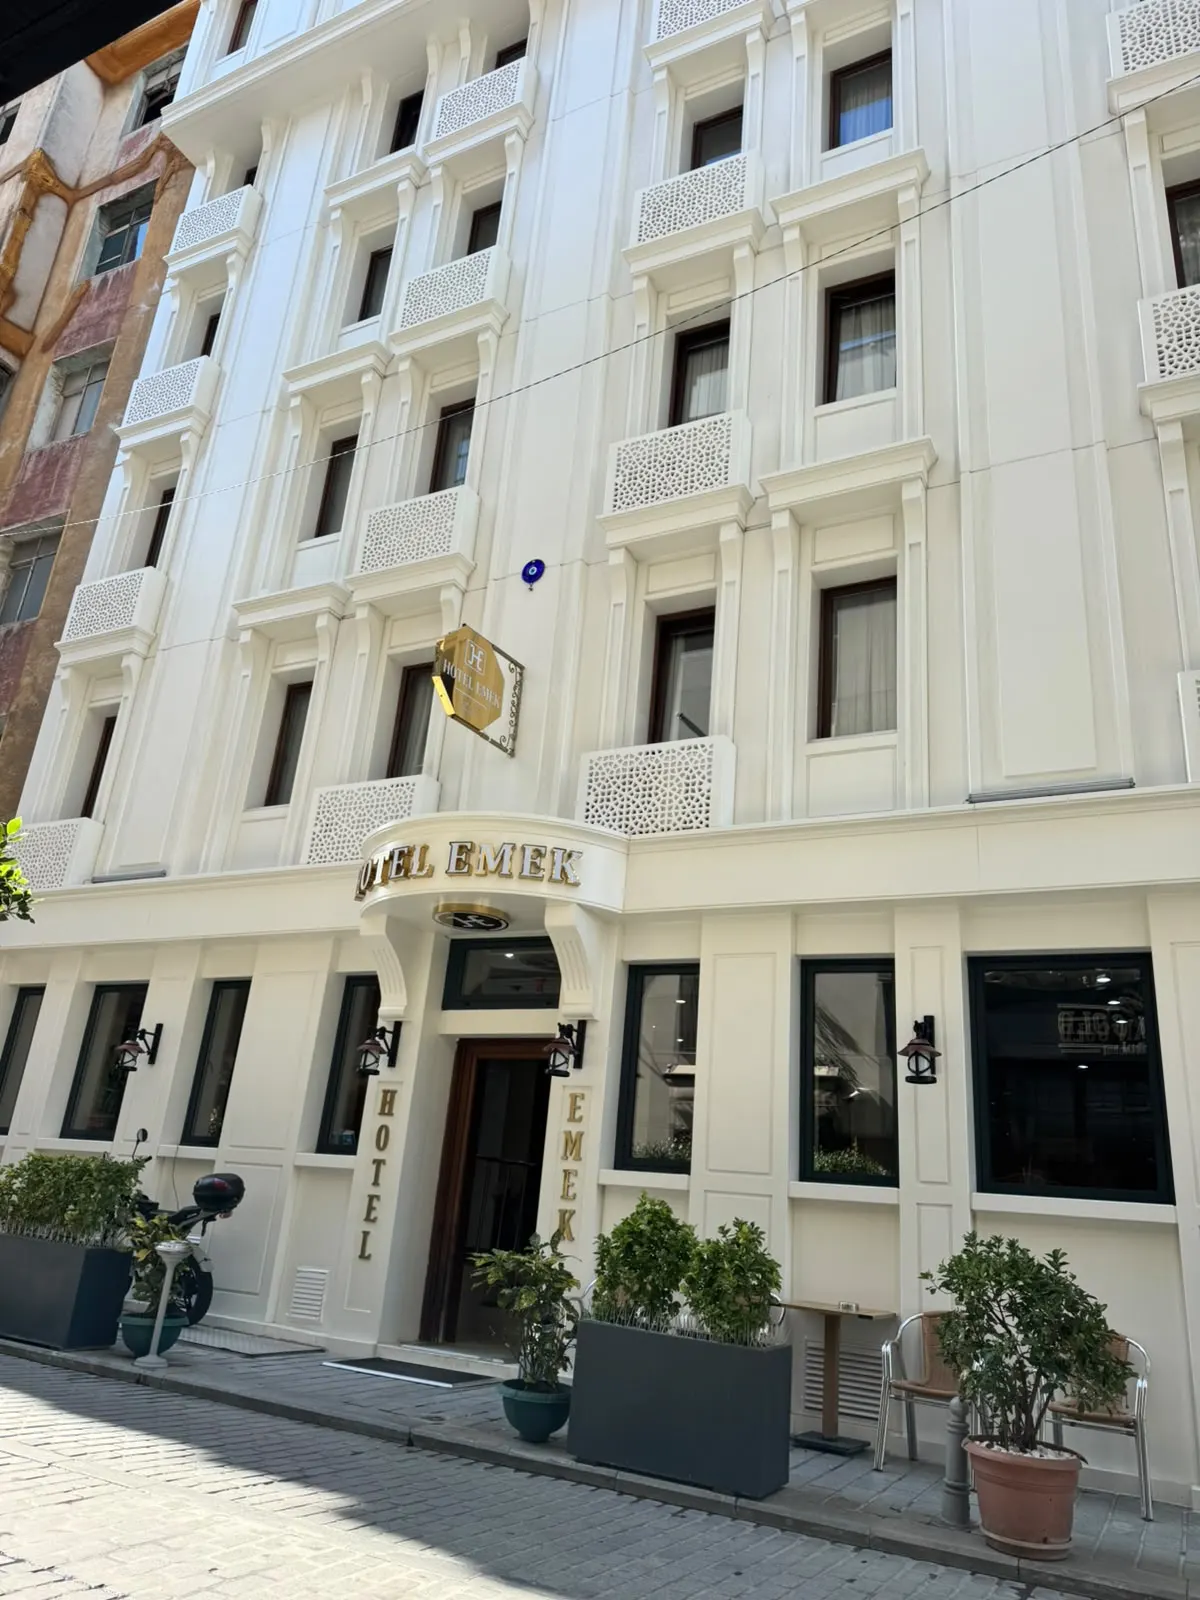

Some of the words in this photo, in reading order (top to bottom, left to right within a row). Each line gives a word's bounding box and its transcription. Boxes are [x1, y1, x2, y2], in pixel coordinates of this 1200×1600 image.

[443, 659, 474, 691] HOTEL
[354, 843, 435, 901] OTEL
[445, 840, 583, 886] EMEK
[358, 1089, 398, 1260] HOTEL
[558, 1092, 585, 1242] EMEK
